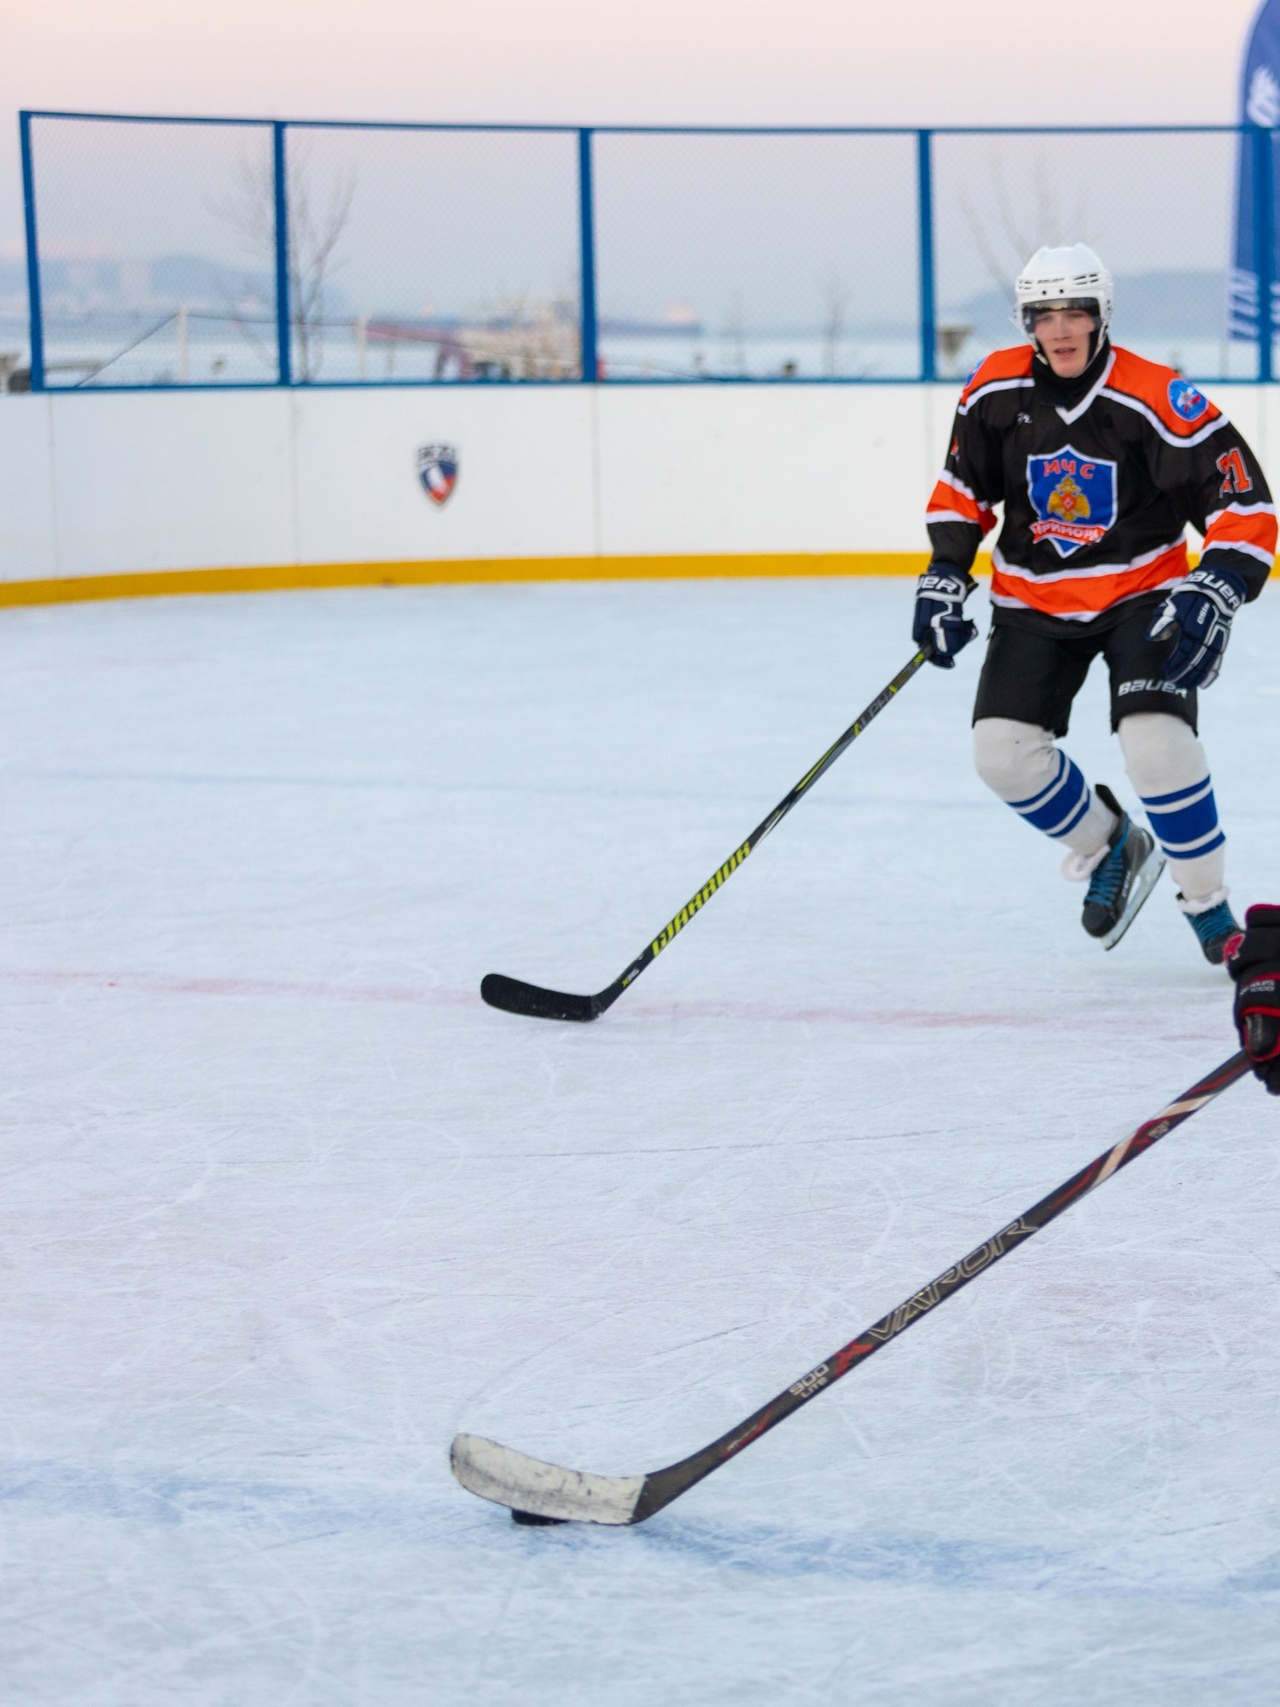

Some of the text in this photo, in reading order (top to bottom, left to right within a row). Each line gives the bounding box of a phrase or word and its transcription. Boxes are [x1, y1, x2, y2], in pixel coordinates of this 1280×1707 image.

[1043, 459, 1095, 479] МЧС
[789, 1364, 829, 1395] 900
[801, 1377, 828, 1398] LITE
